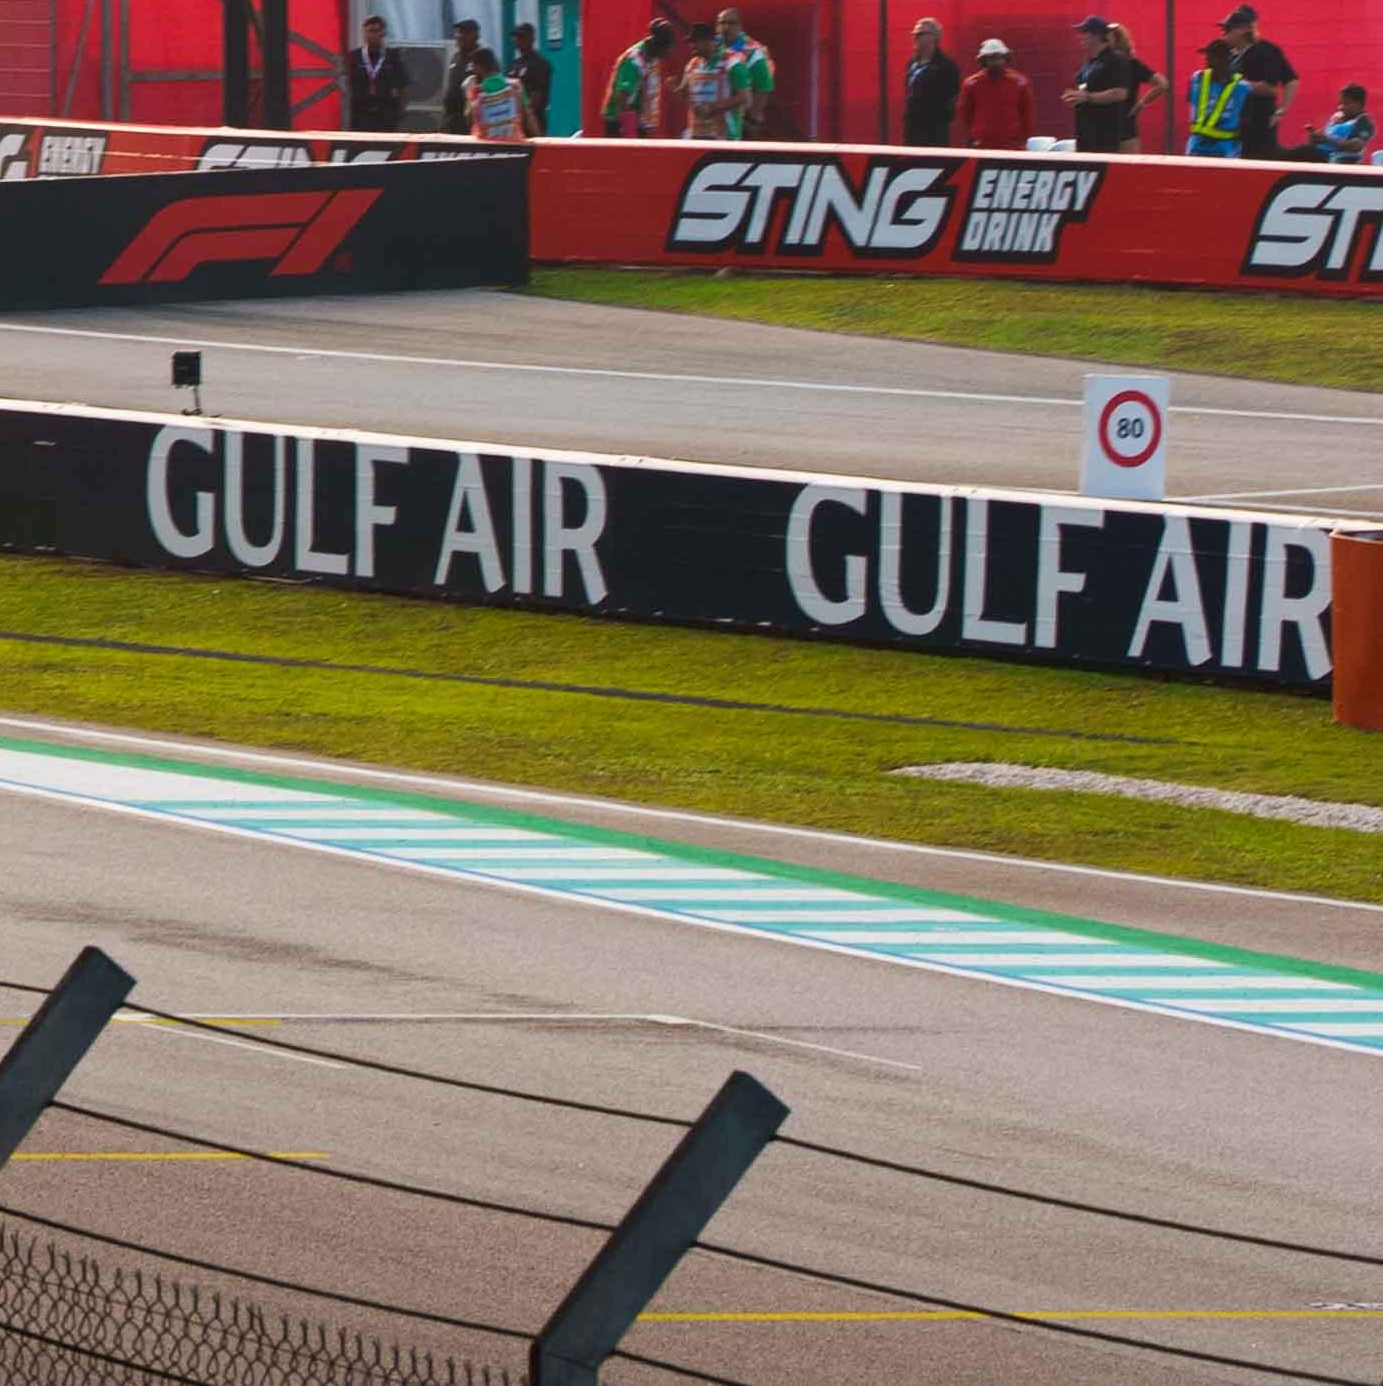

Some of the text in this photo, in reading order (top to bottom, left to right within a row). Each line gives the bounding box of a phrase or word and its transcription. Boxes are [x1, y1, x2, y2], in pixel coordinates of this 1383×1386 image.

[674, 162, 1100, 249] STING ENERGY
[961, 212, 1061, 253] DRINK
[1115, 416, 1145, 440] 80
[148, 425, 608, 606] GULF AIR
[786, 484, 1334, 682] GULF AIR
